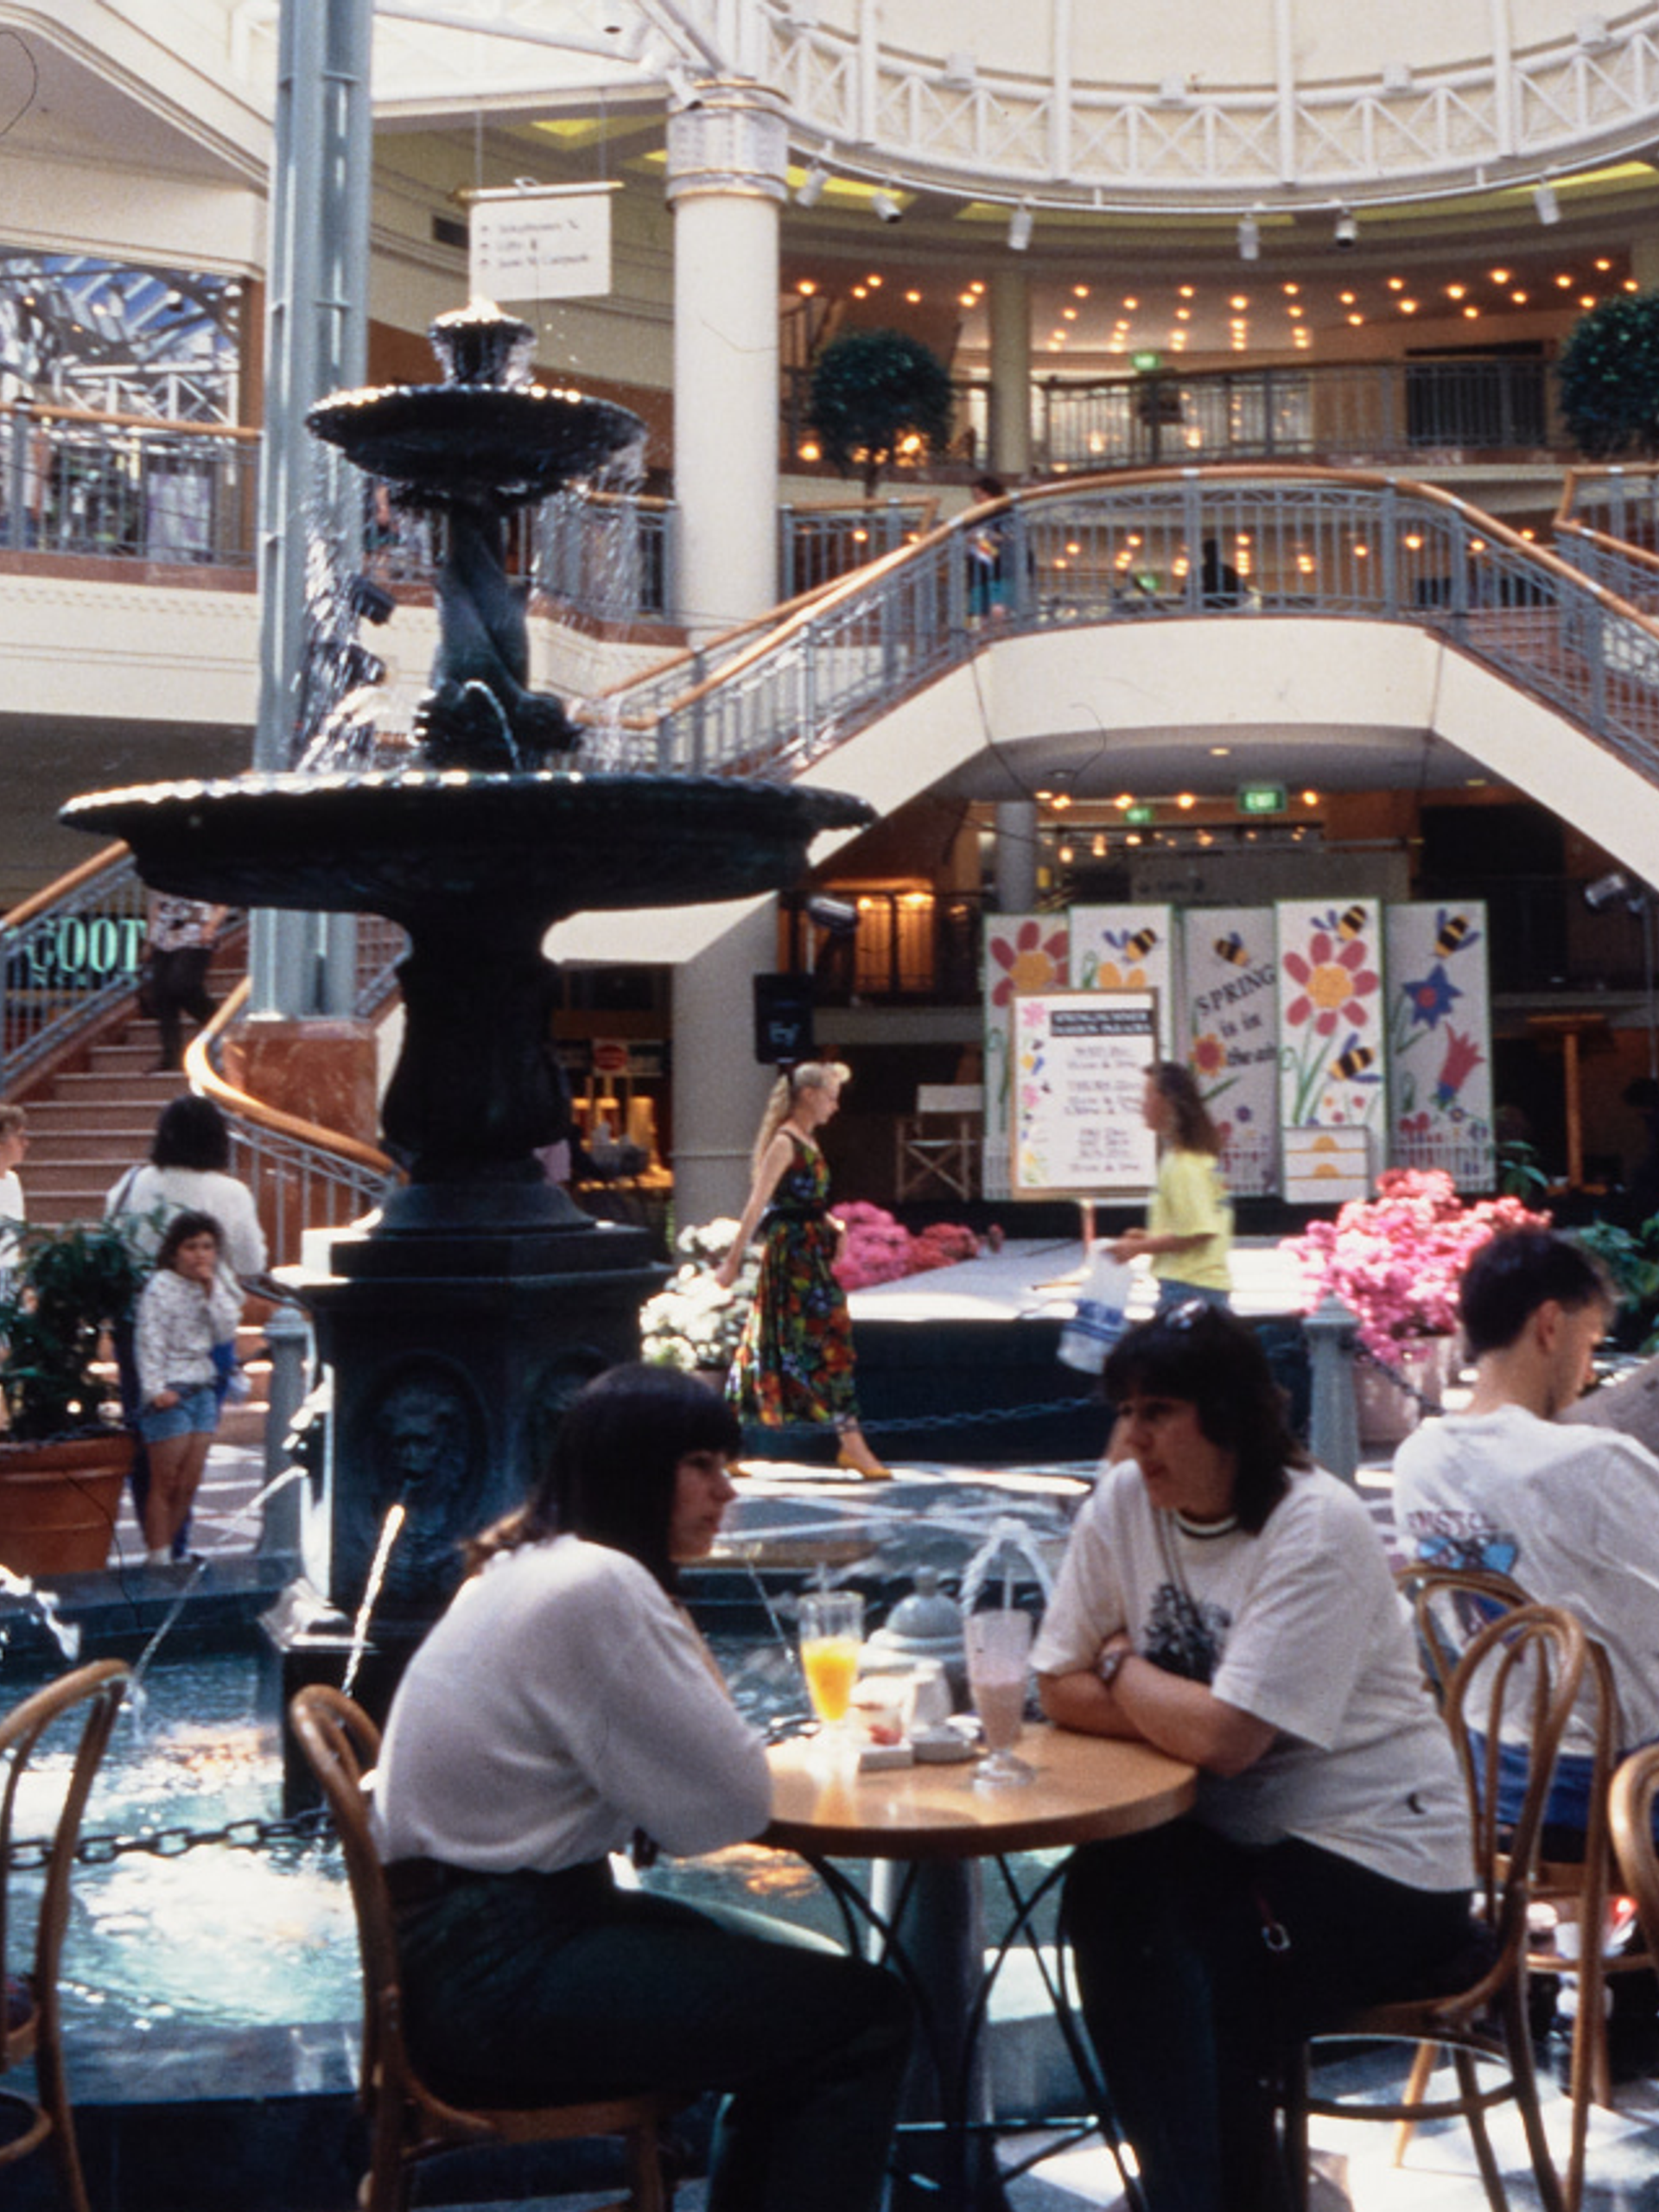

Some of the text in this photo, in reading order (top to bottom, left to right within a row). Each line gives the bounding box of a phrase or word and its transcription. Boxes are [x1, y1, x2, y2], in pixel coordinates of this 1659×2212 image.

[1195, 963, 1277, 1016] SPRING
[1219, 1010, 1262, 1039] is in
[1227, 1046, 1251, 1066] the
